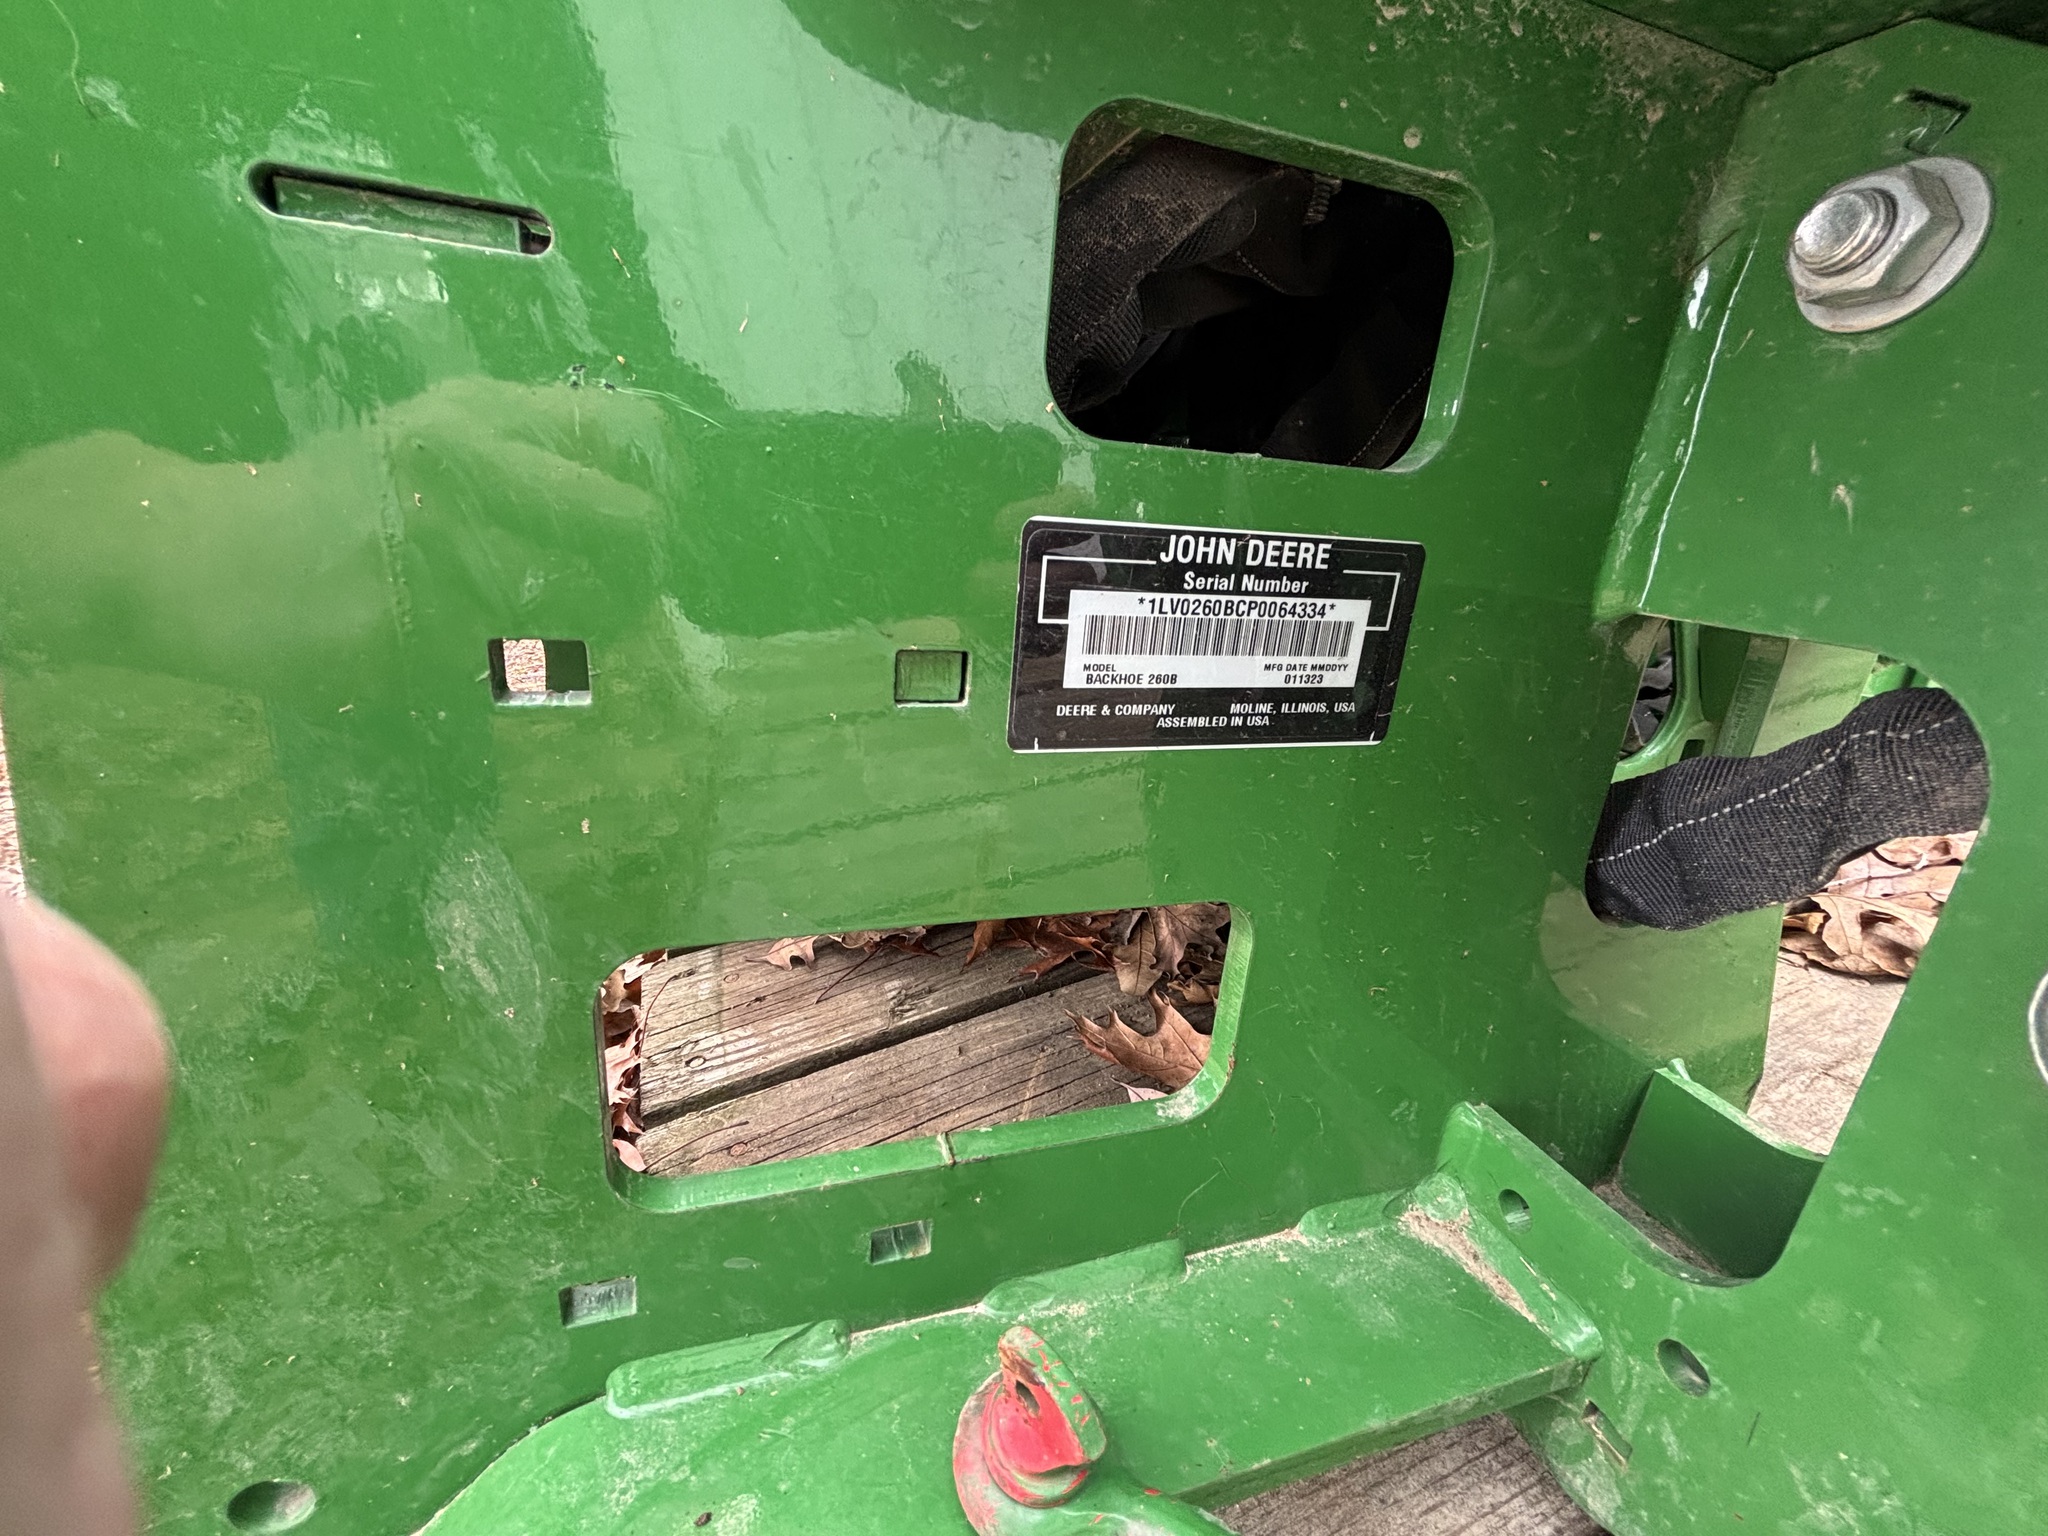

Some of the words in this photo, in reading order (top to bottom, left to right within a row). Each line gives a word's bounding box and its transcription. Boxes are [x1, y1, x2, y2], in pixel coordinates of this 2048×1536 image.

[1159, 534, 1237, 565] JOHN
[1245, 539, 1332, 569] DEERE
[1183, 571, 1235, 591] Serial
[1241, 573, 1310, 593] Number
[1083, 663, 1116, 672] MODEL
[1264, 663, 1283, 672] MFG
[1286, 663, 1308, 672] DATE
[1310, 663, 1348, 672] MMDDYY
[1086, 673, 1144, 685] BACKHOE
[1148, 674, 1178, 685] 260B
[1284, 673, 1324, 684] 011323
[1056, 704, 1097, 716] DEERE
[1101, 704, 1111, 716] &
[1114, 703, 1176, 716] COMPANY
[1230, 703, 1277, 715] MOLINE,
[1281, 702, 1330, 714] ILLINOIS,
[1334, 702, 1356, 713] USA
[1156, 716, 1227, 728] ASSEMBLED
[1230, 716, 1243, 727] IN
[1246, 716, 1270, 727] USA
